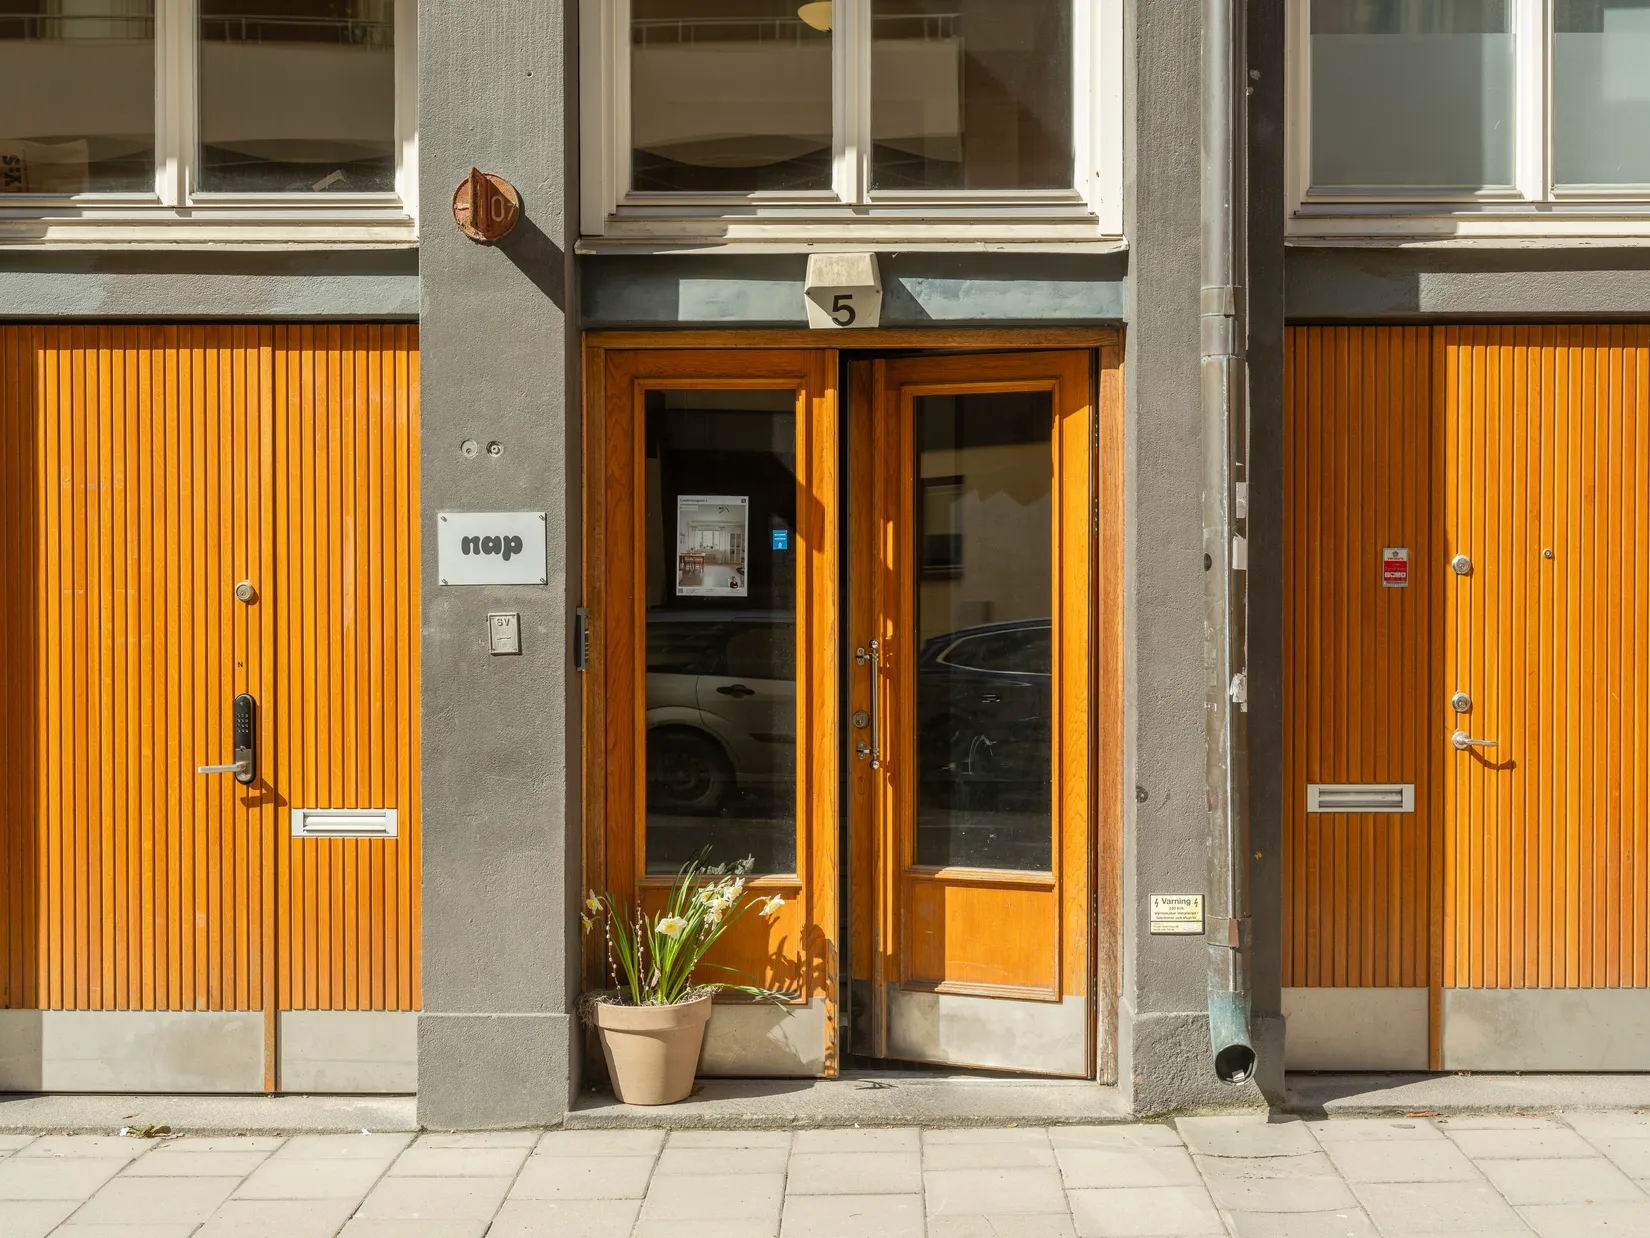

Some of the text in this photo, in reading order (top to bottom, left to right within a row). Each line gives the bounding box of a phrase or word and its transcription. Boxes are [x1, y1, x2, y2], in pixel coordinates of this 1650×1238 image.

[831, 294, 856, 327] 5
[461, 535, 523, 561] nap
[496, 617, 510, 627] SV
[1161, 897, 1191, 906] Varning
